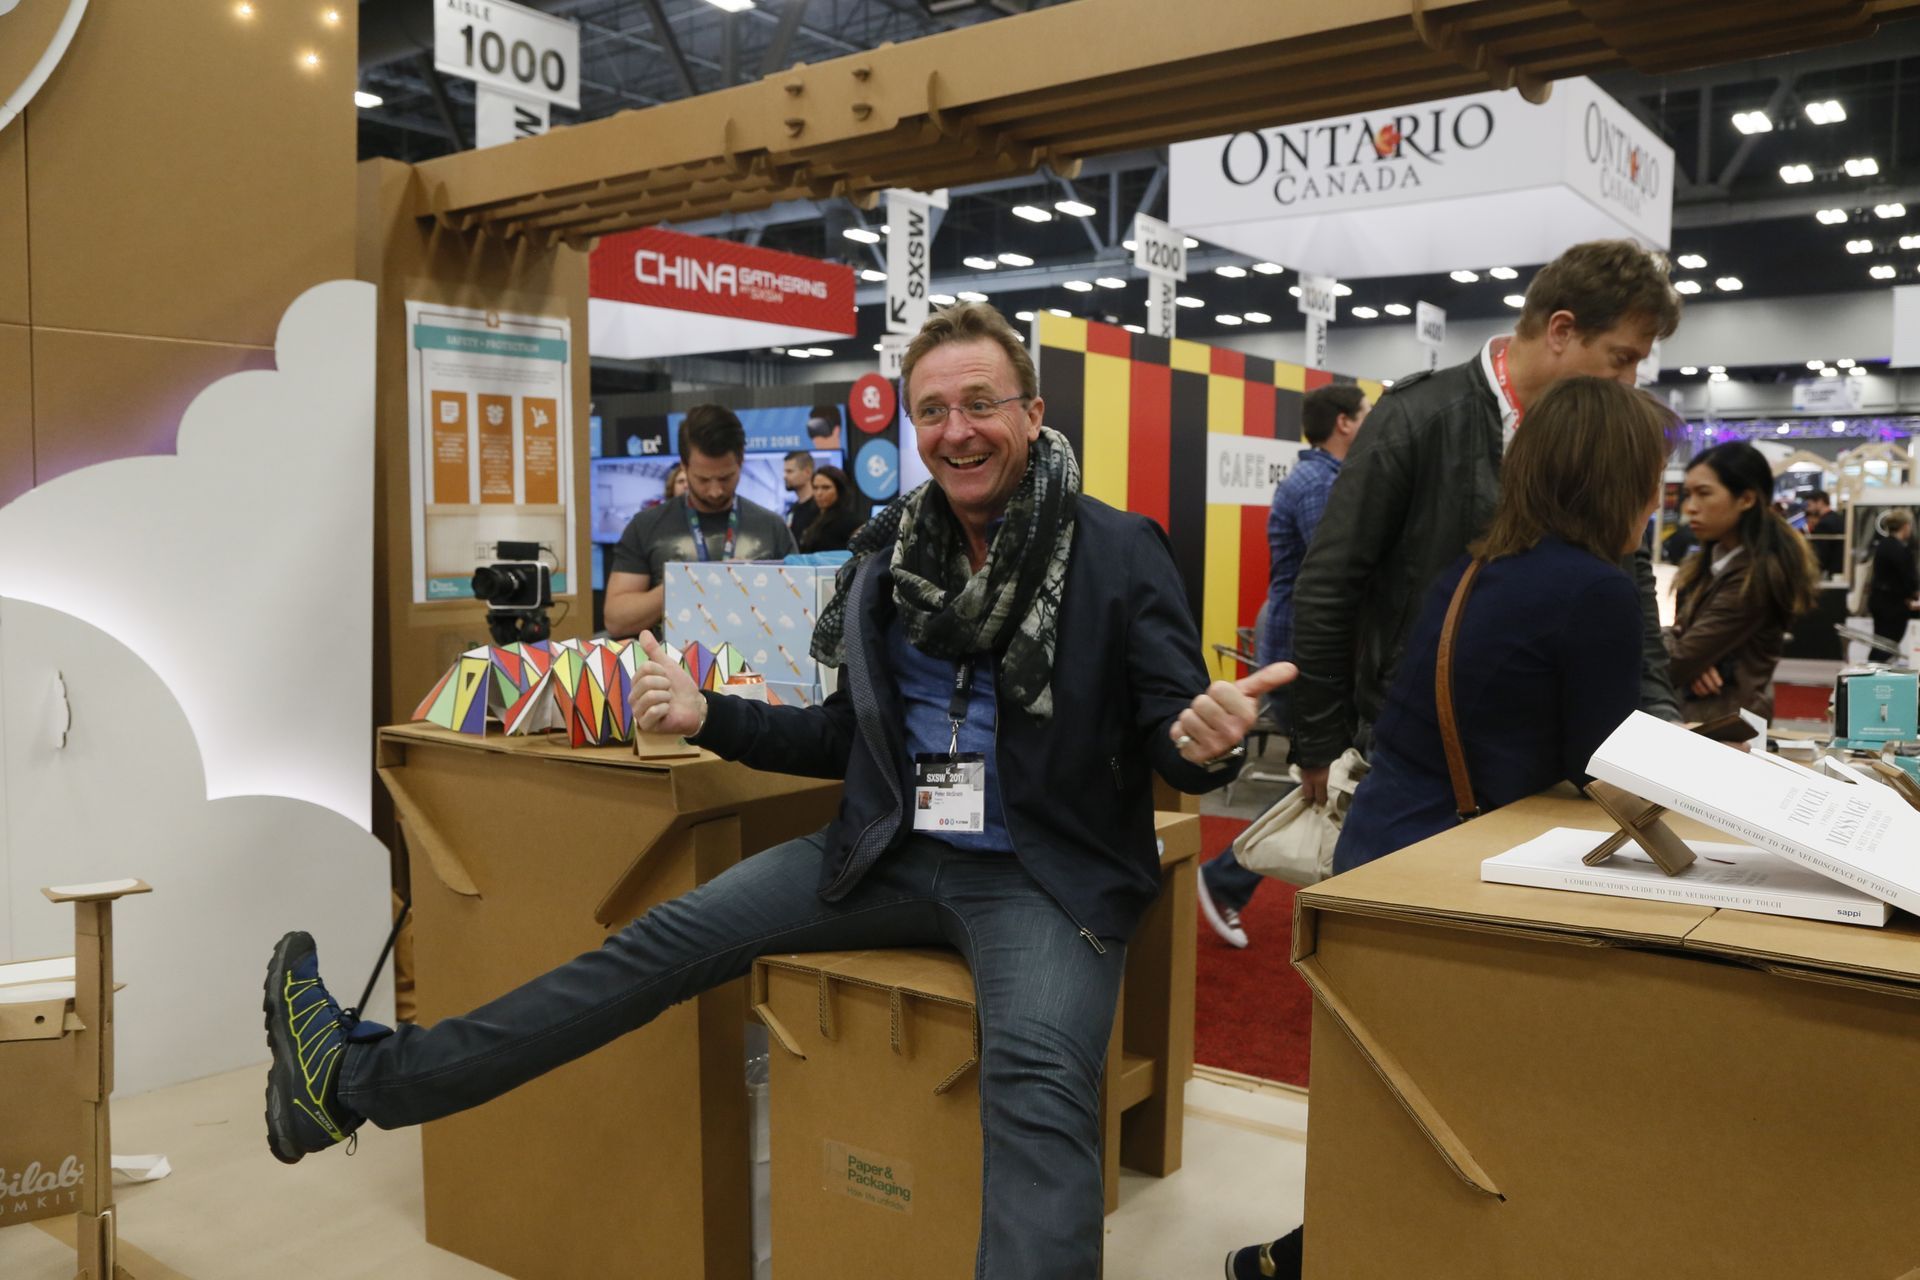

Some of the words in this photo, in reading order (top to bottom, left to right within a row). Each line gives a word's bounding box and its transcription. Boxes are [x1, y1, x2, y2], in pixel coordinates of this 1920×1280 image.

[461, 25, 565, 92] 1000
[1221, 103, 1494, 186] ONTARIO
[1273, 164, 1422, 205] CANADA
[908, 209, 924, 299] SXSW
[1146, 239, 1181, 271] 1200
[634, 249, 738, 297] CHINA
[739, 267, 828, 299] GATHERING
[926, 773, 946, 783] SXSW
[949, 773, 965, 783] 2017
[1743, 828, 1767, 842] GUIDE
[1768, 838, 1780, 848] TO
[1781, 844, 1797, 855] THE
[1799, 851, 1855, 880] NEUROSCIENCE
[1857, 876, 1868, 886] OF
[1871, 880, 1899, 899] TOUCH
[1631, 885, 1653, 893] GUIDE
[1685, 891, 1741, 904] NEUROSCIENCE
[1756, 899, 1782, 909] TOUCH
[1837, 908, 1861, 918] sappi
[848, 1155, 883, 1176] Paper
[885, 1166, 894, 1180] &
[848, 1168, 912, 1201] Packaging
